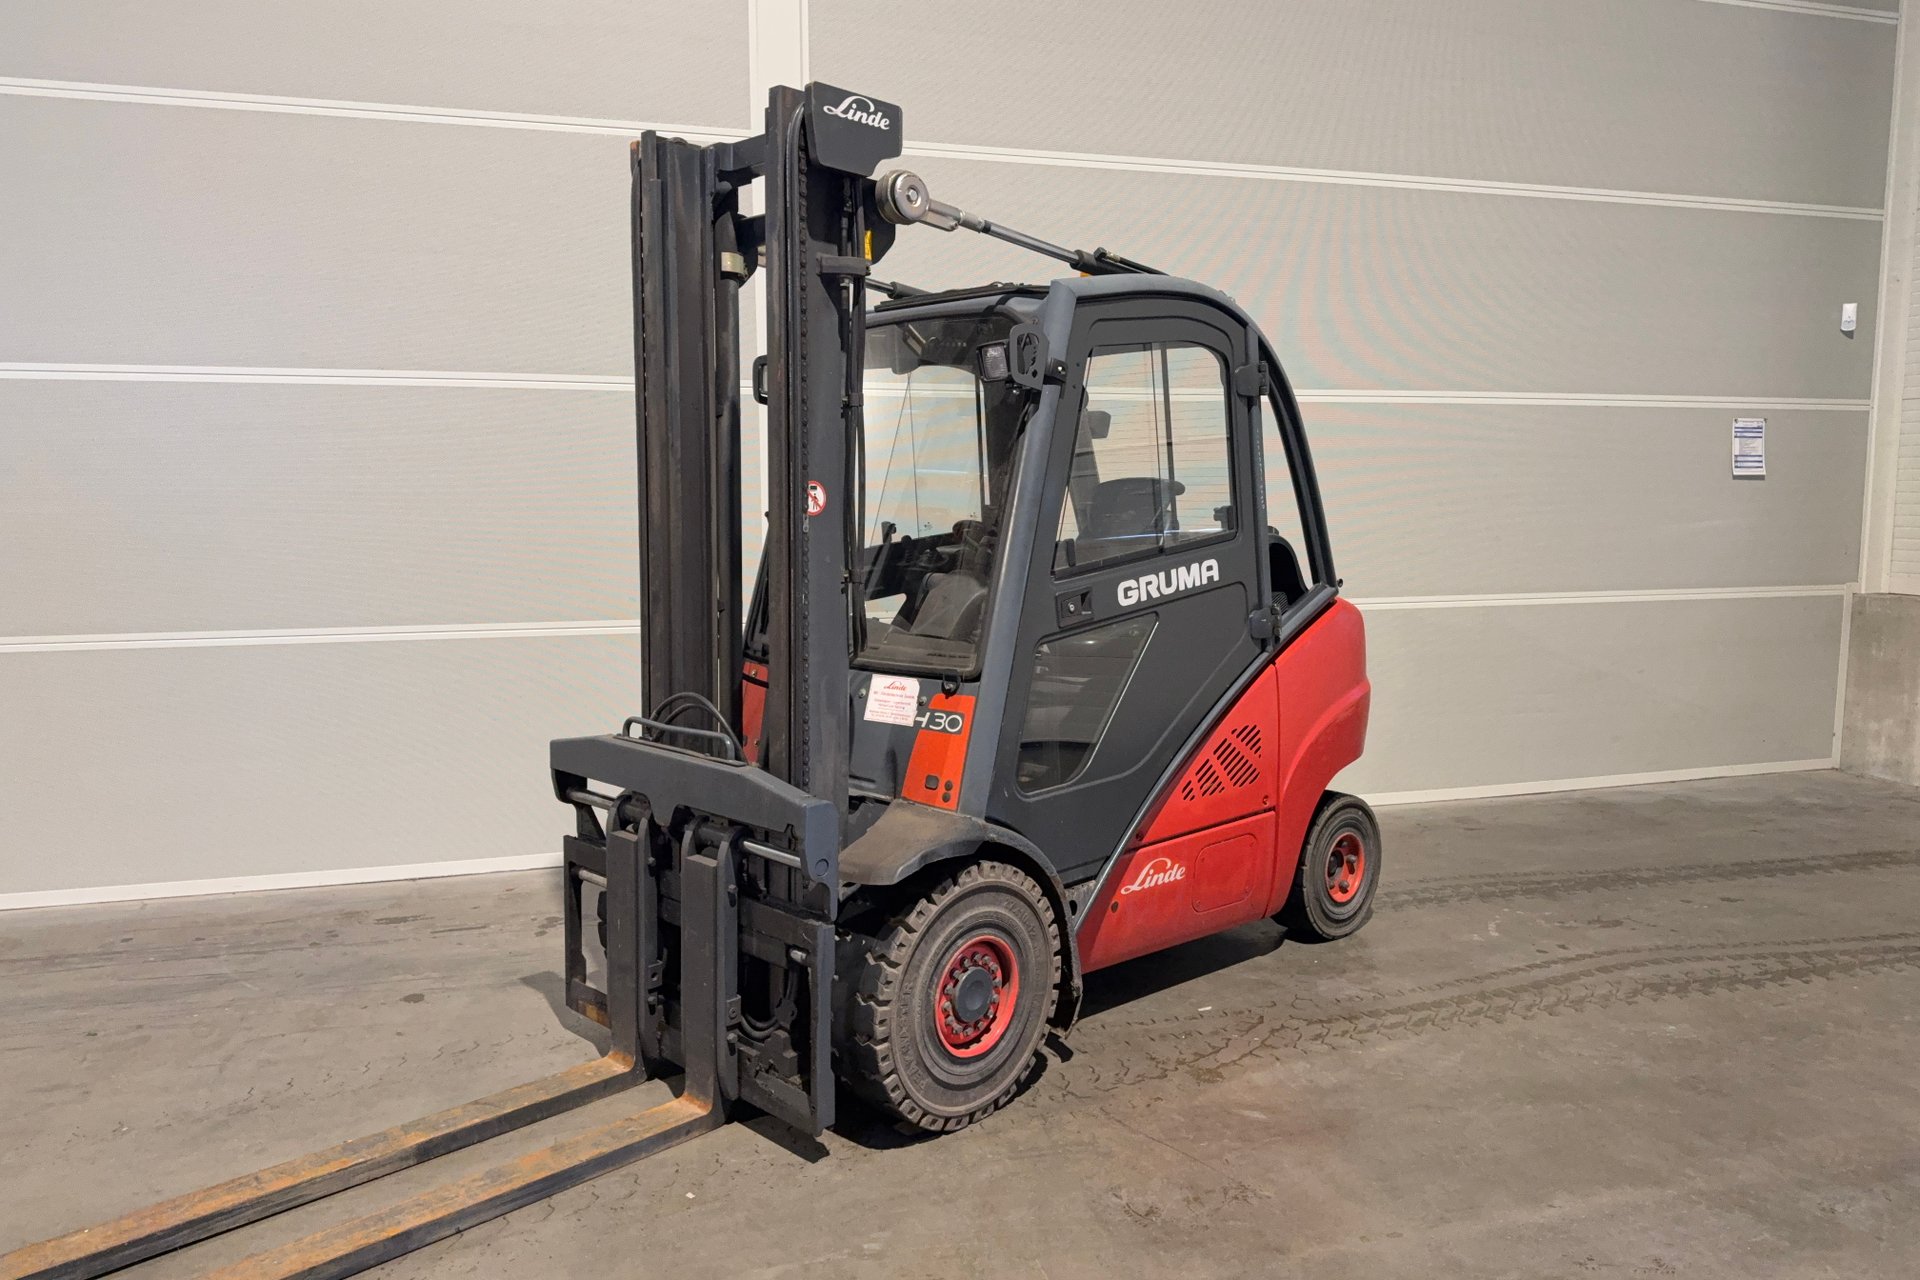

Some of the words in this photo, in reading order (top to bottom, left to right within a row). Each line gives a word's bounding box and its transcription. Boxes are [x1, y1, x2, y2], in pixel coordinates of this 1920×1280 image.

[823, 95, 890, 130] Linde
[1117, 558, 1219, 606] GRUMA
[884, 680, 907, 691] Linde
[1120, 857, 1186, 895] Linde
